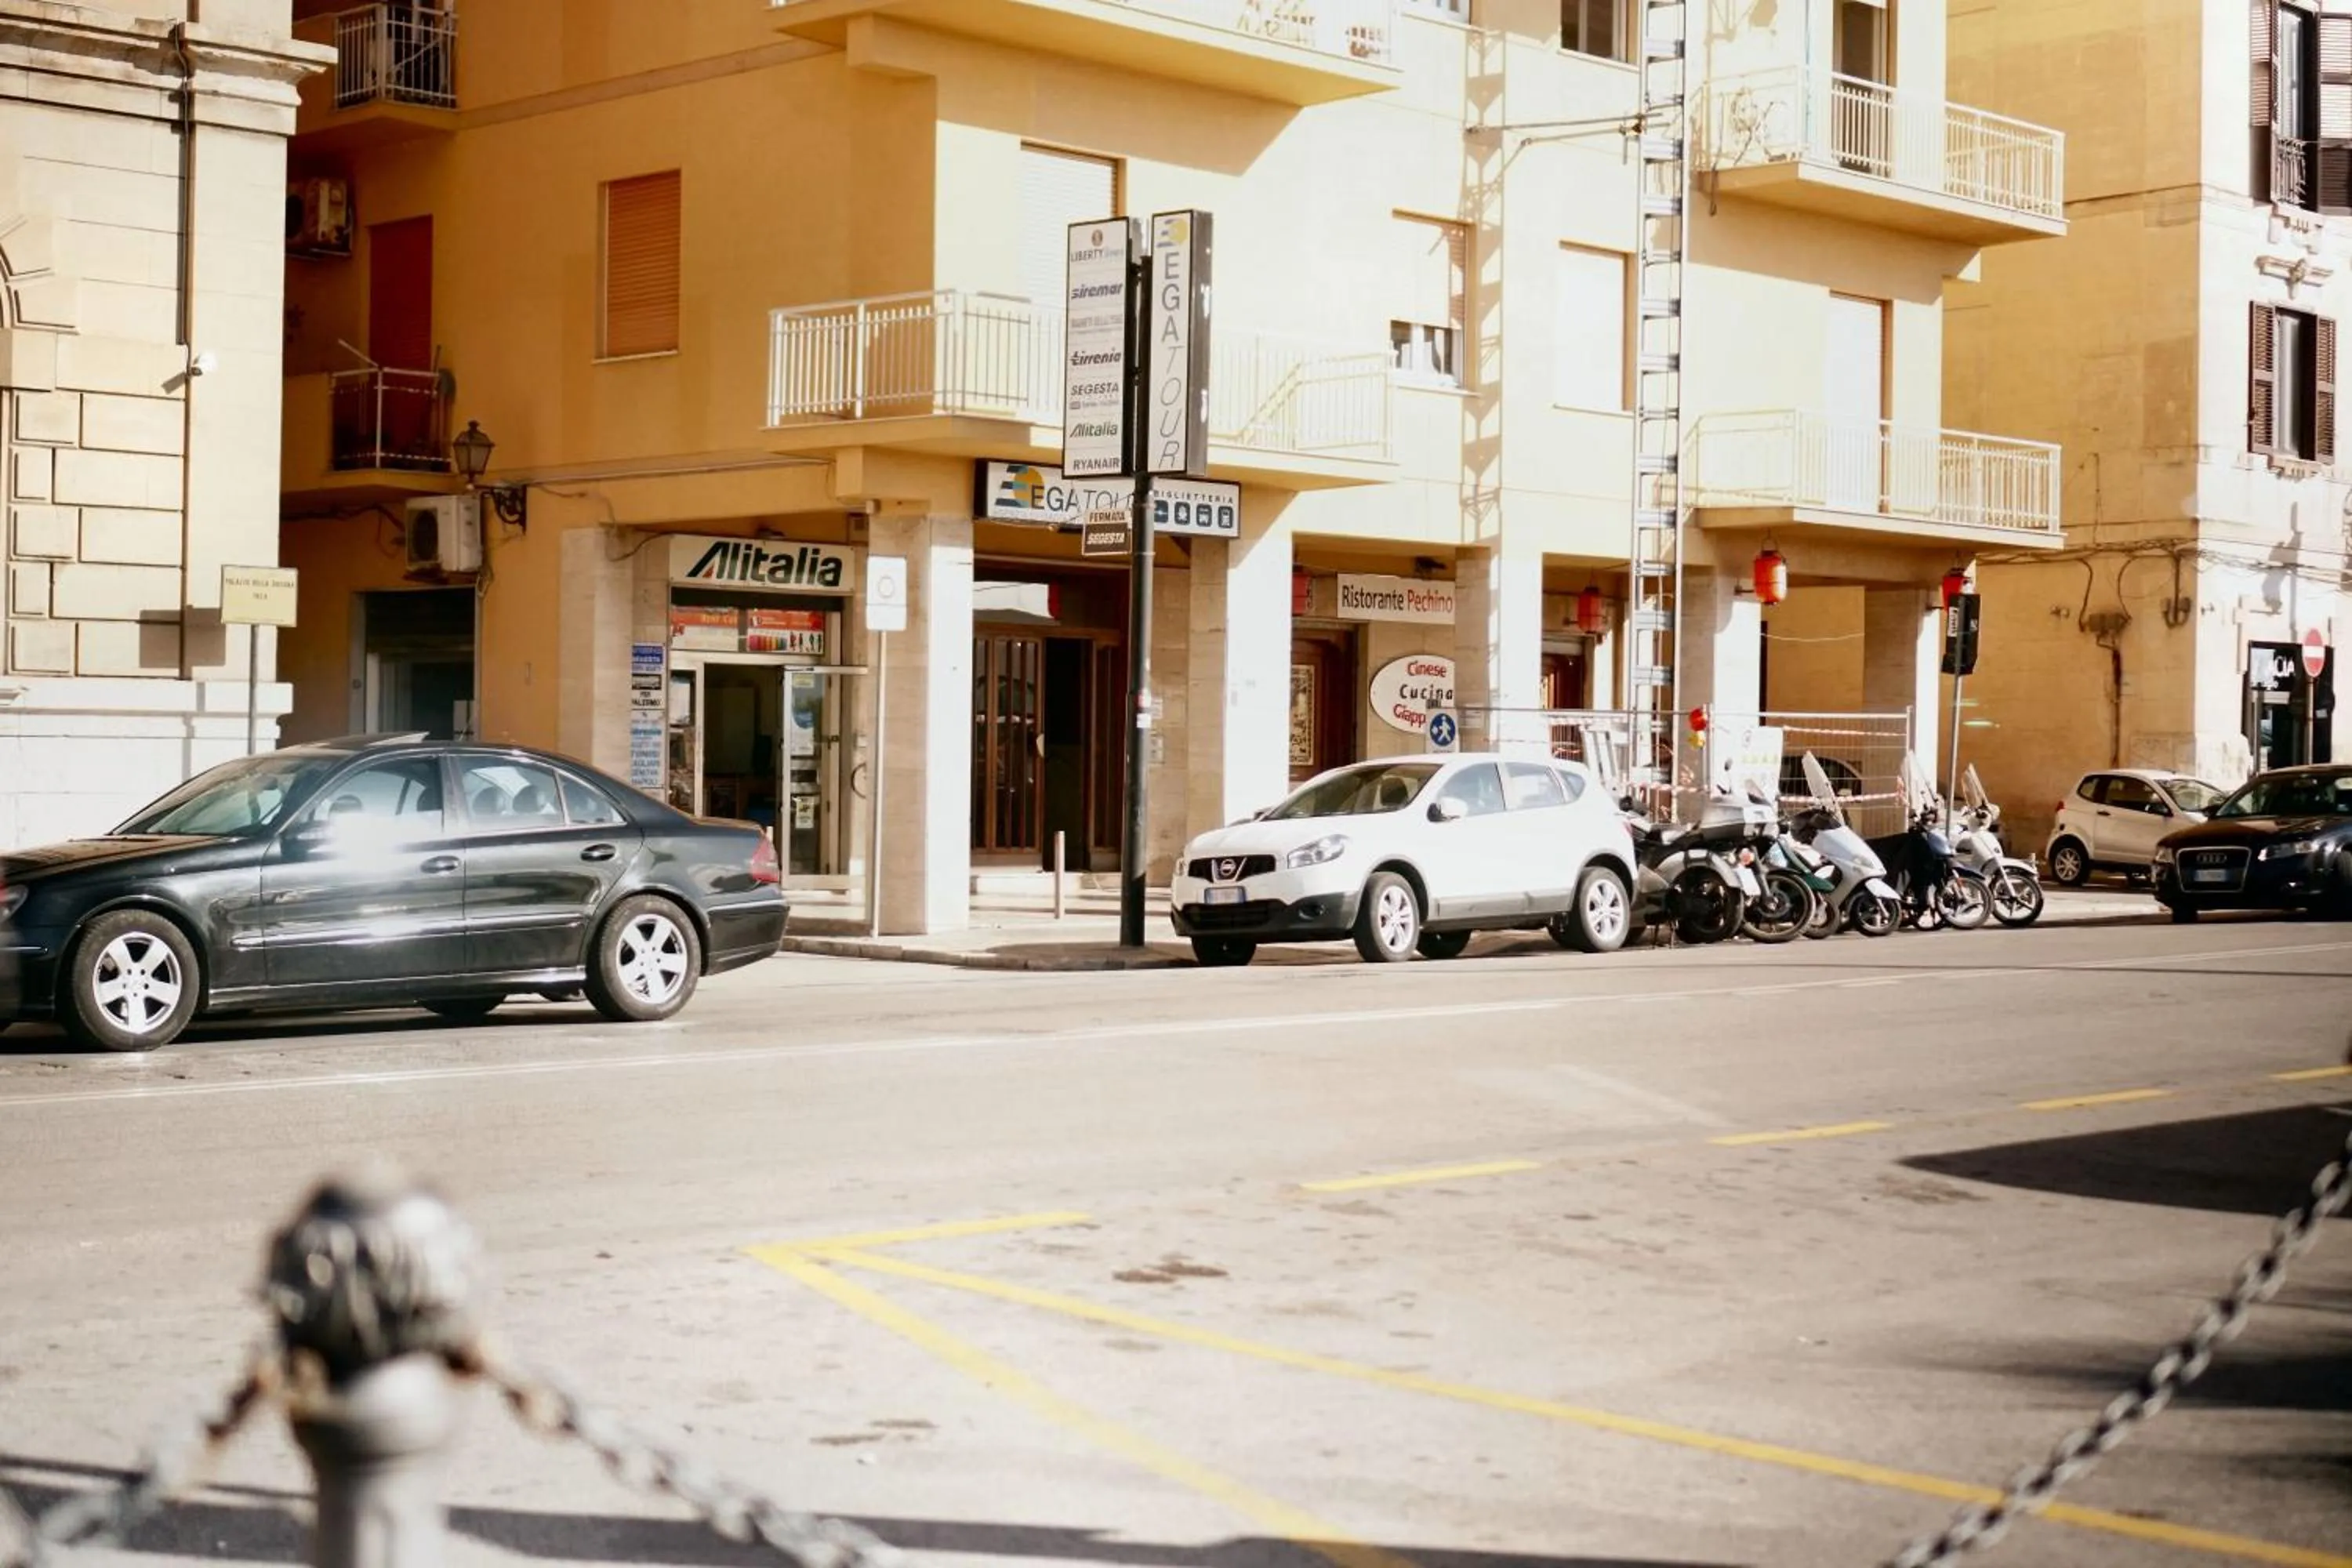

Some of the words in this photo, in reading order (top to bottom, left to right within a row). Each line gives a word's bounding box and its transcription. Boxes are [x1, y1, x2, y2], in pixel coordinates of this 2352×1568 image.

[1071, 382, 1119, 396] SEGESTA
[1069, 421, 1118, 438] Alitalia
[1073, 457, 1120, 470] RYANAIR
[1031, 485, 1132, 513] EGATOU
[686, 541, 843, 587] Alitalia
[1341, 586, 1404, 611] Ristorante
[1407, 589, 1453, 613] Pechino
[1407, 660, 1446, 677] Cinese
[1399, 684, 1454, 700] Cucina
[1393, 704, 1426, 728] Giapp
